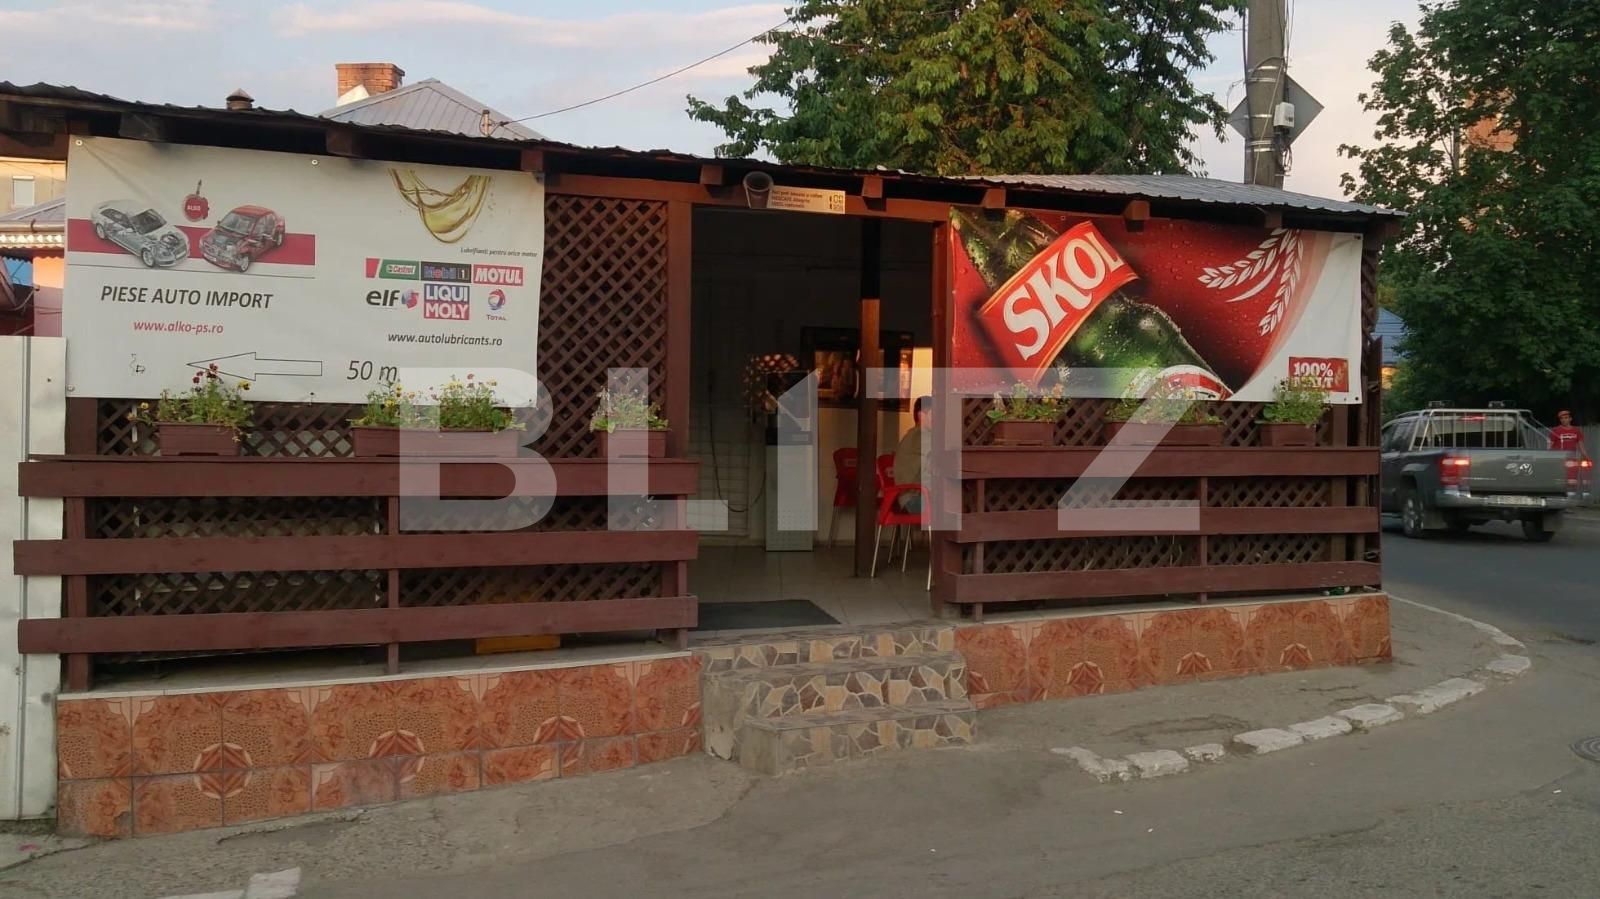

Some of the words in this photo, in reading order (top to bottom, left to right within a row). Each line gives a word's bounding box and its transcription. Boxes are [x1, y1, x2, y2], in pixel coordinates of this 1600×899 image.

[393, 265, 414, 275] Castrol
[424, 265, 457, 280] Mobil
[475, 267, 522, 284] MOTUL
[101, 285, 148, 303] PIESE
[151, 288, 201, 306] AUTO
[206, 290, 274, 309] IMPORT
[366, 289, 400, 307] elf
[425, 284, 468, 302] LIQUI
[1003, 231, 1124, 361] SKOL
[425, 302, 469, 319] MOLY
[133, 320, 224, 336] www.alko-ps.ro
[388, 332, 503, 346] www.autolubricants.ro
[346, 360, 373, 381] 50
[379, 365, 398, 382] m
[1294, 361, 1334, 377] 100%
